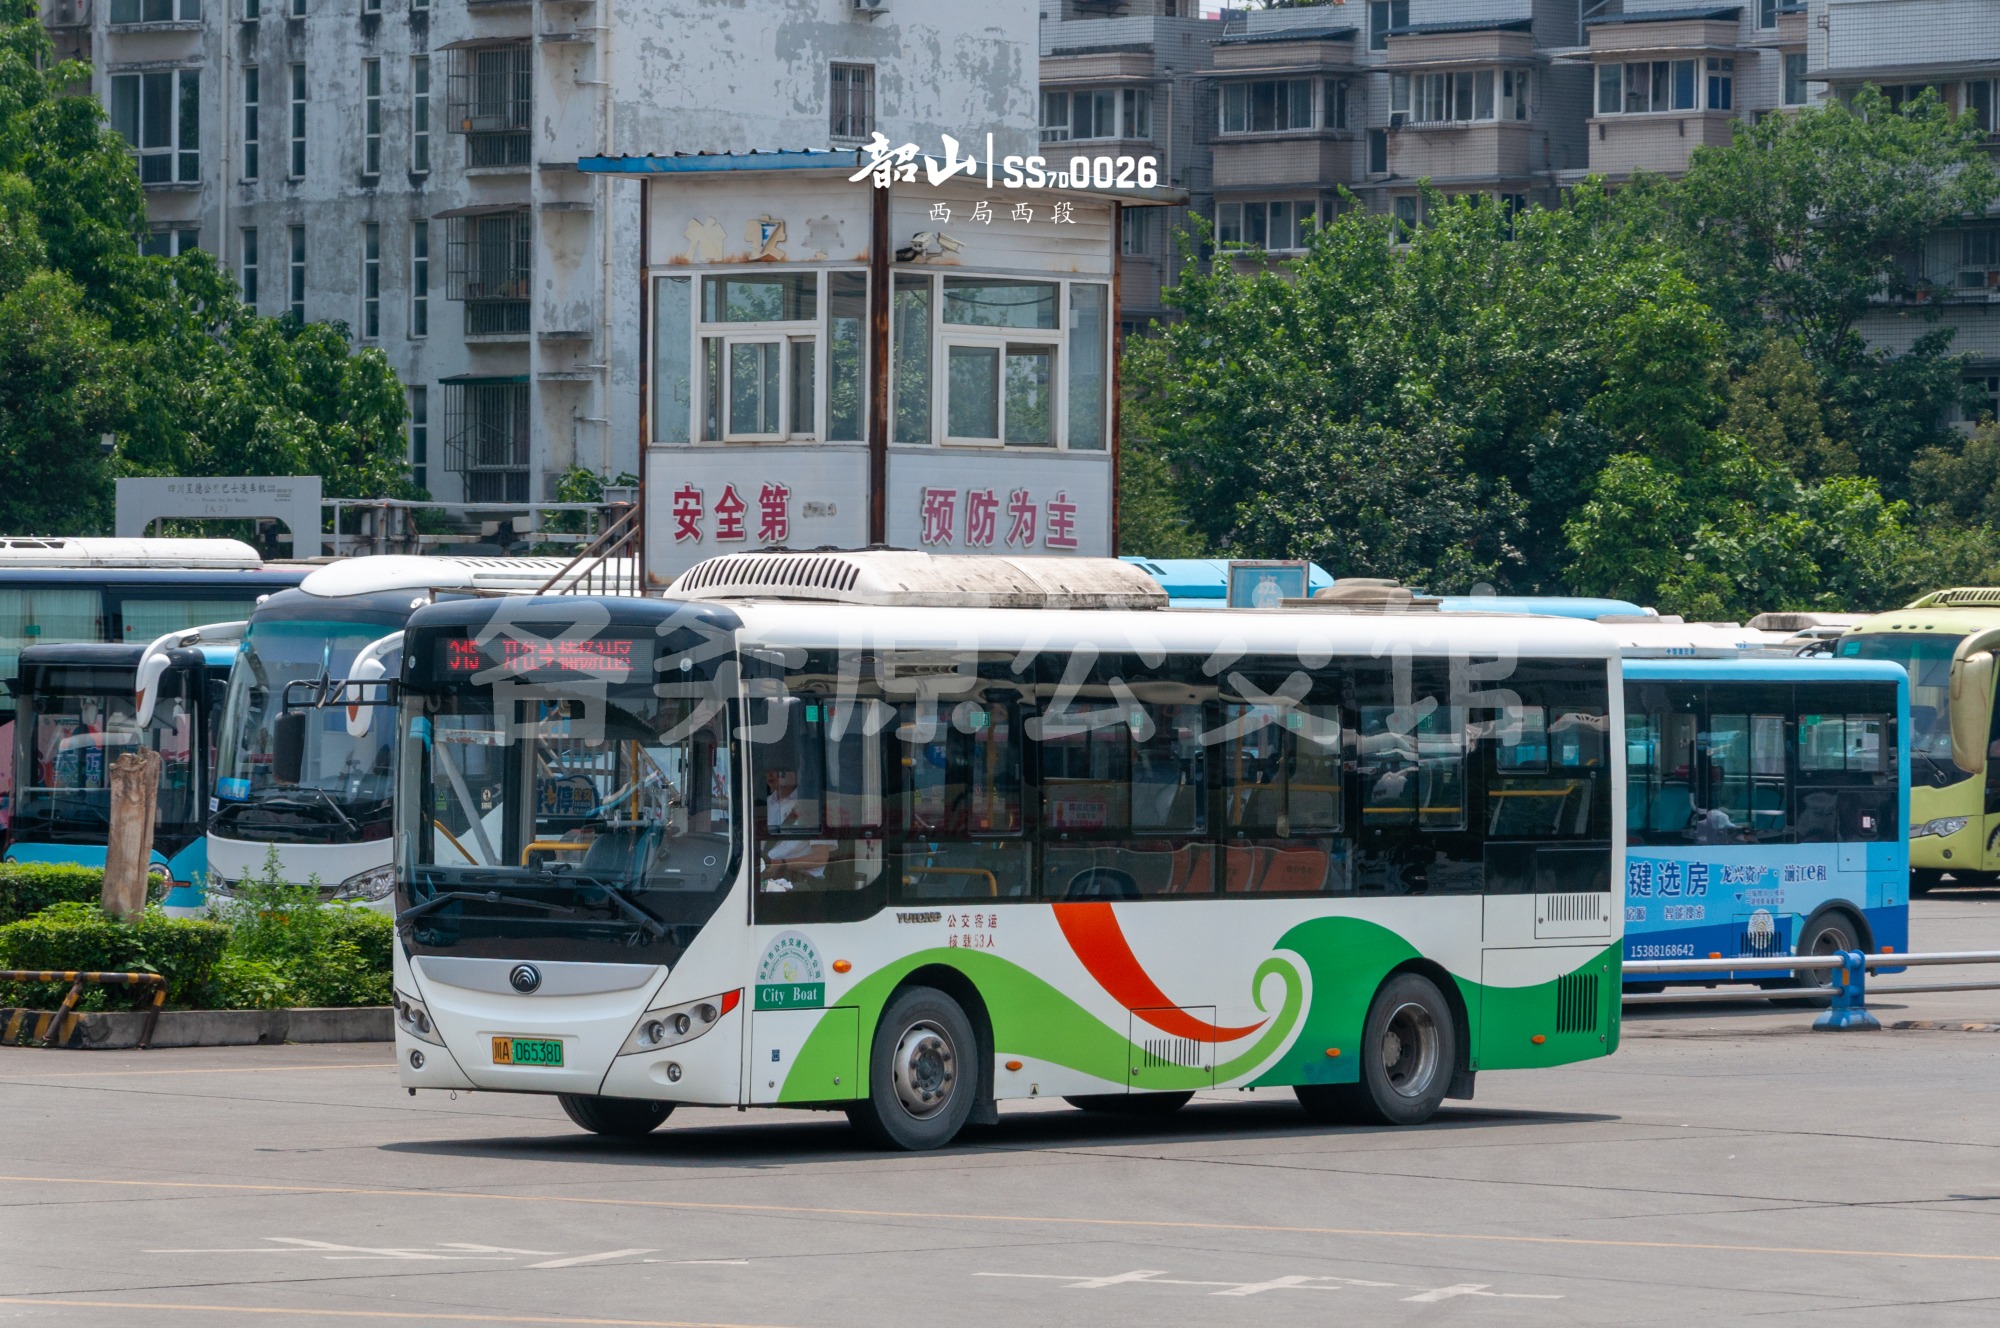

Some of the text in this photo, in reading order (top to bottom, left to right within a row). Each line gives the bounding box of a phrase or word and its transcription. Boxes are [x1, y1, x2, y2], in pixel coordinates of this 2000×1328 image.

[673, 485, 790, 541] 安全第
[922, 489, 1078, 548] 预防为主
[450, 640, 479, 670] 315
[1629, 861, 1709, 897] 键选房
[896, 911, 941, 923] YUTONG
[947, 914, 997, 928] 公交客运
[949, 934, 996, 948] 核载53人
[1631, 944, 1694, 958] 15388168642
[763, 986, 817, 1004] City Boat
